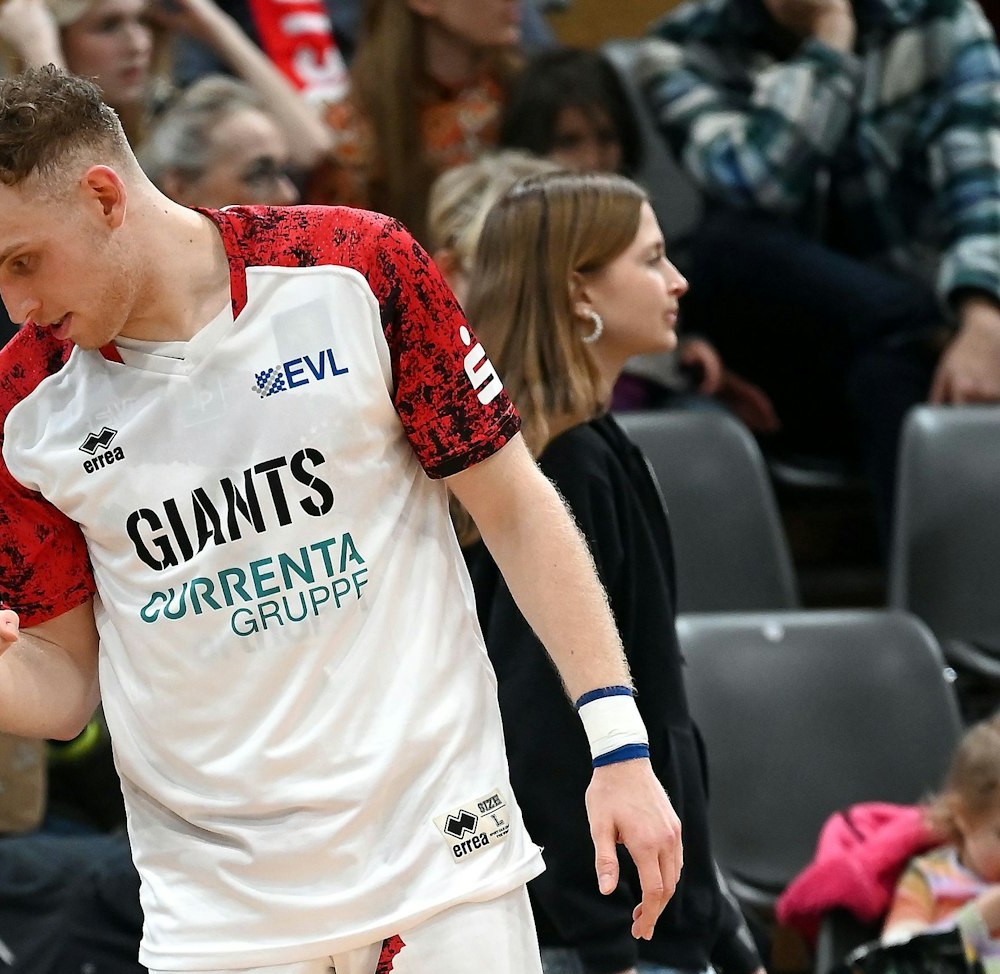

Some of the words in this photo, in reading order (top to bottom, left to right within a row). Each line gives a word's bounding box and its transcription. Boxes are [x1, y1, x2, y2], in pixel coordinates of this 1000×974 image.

[284, 348, 349, 390] EVL
[126, 448, 334, 571] GIANTS
[140, 532, 365, 623] CURRENTA
[477, 794, 503, 813] SIZE
